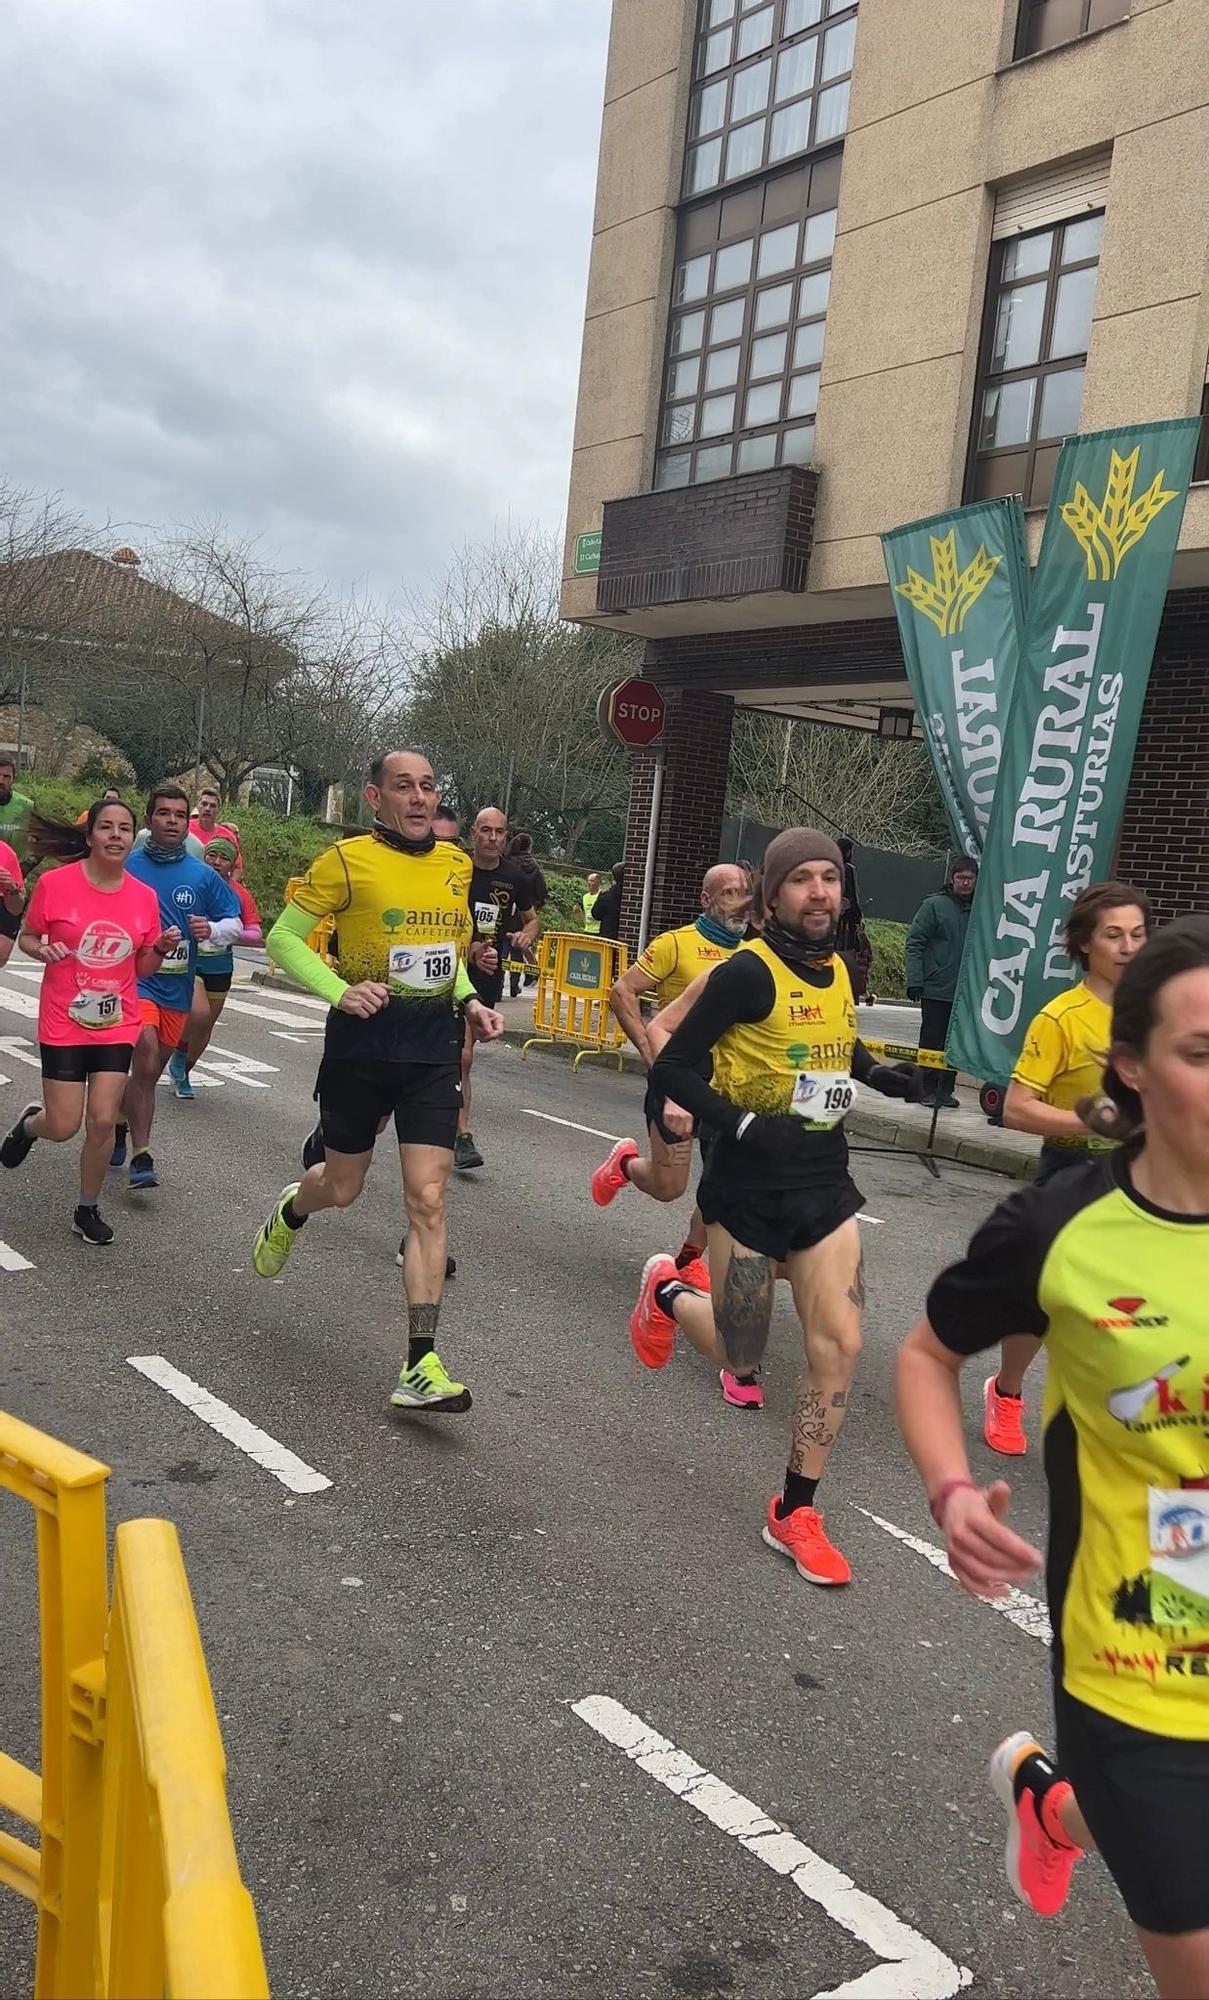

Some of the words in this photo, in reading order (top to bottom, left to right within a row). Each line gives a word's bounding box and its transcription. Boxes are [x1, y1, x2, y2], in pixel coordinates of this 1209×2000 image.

[618, 702, 661, 723] STOP
[1011, 602, 1105, 854] RURAL
[1060, 671, 1124, 902] ASTURIAS
[475, 910, 494, 922] 105
[981, 870, 1050, 1036] CAJA
[423, 956, 451, 978] 138
[97, 997, 117, 1015] 157
[824, 1088, 853, 1110] 198
